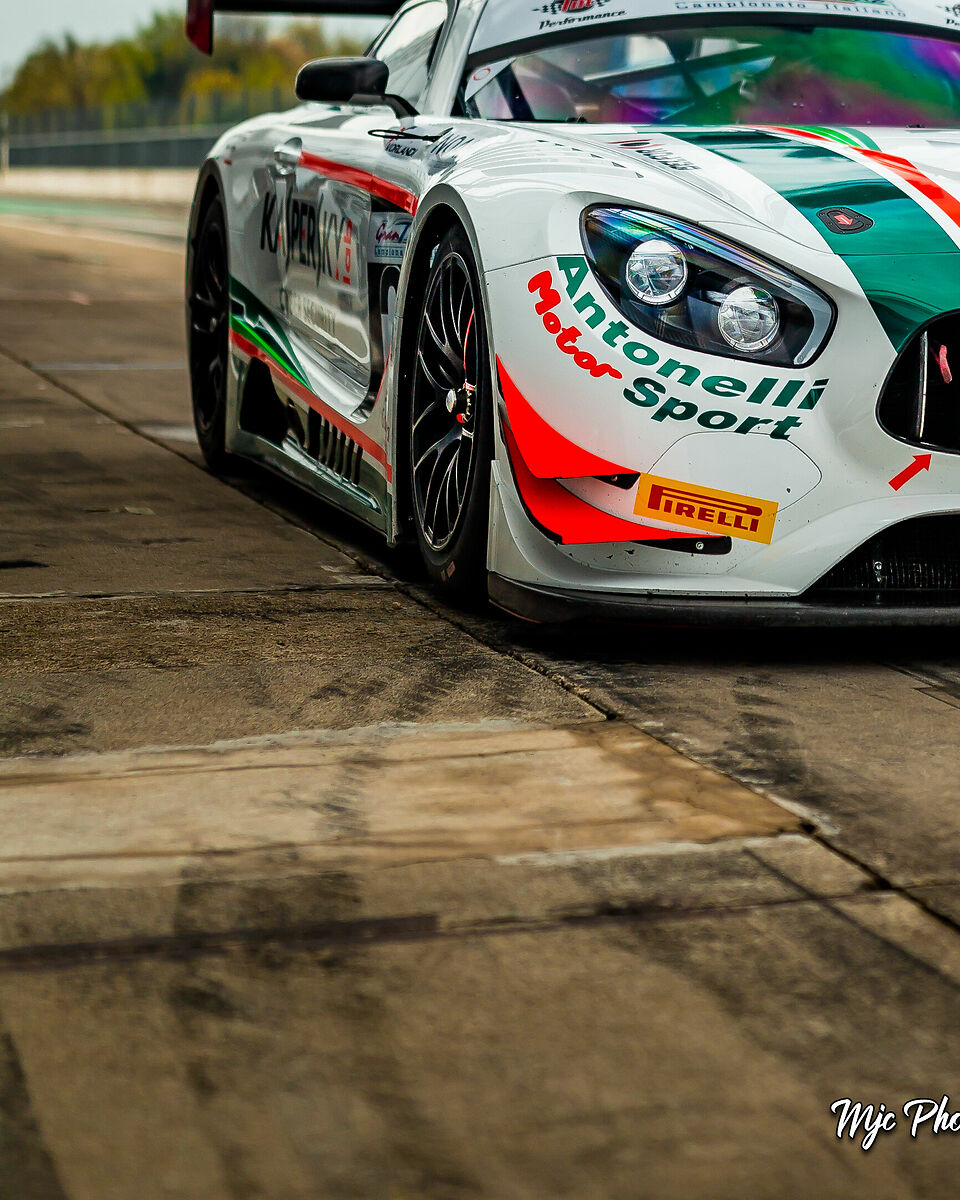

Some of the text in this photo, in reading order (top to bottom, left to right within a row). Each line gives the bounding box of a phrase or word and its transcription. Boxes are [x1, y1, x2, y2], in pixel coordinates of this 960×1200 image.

[538, 10, 627, 30] Performance
[527, 270, 802, 440] Motor Sport
[556, 256, 829, 410] Antonelli
[648, 484, 763, 532] PIRELLI
